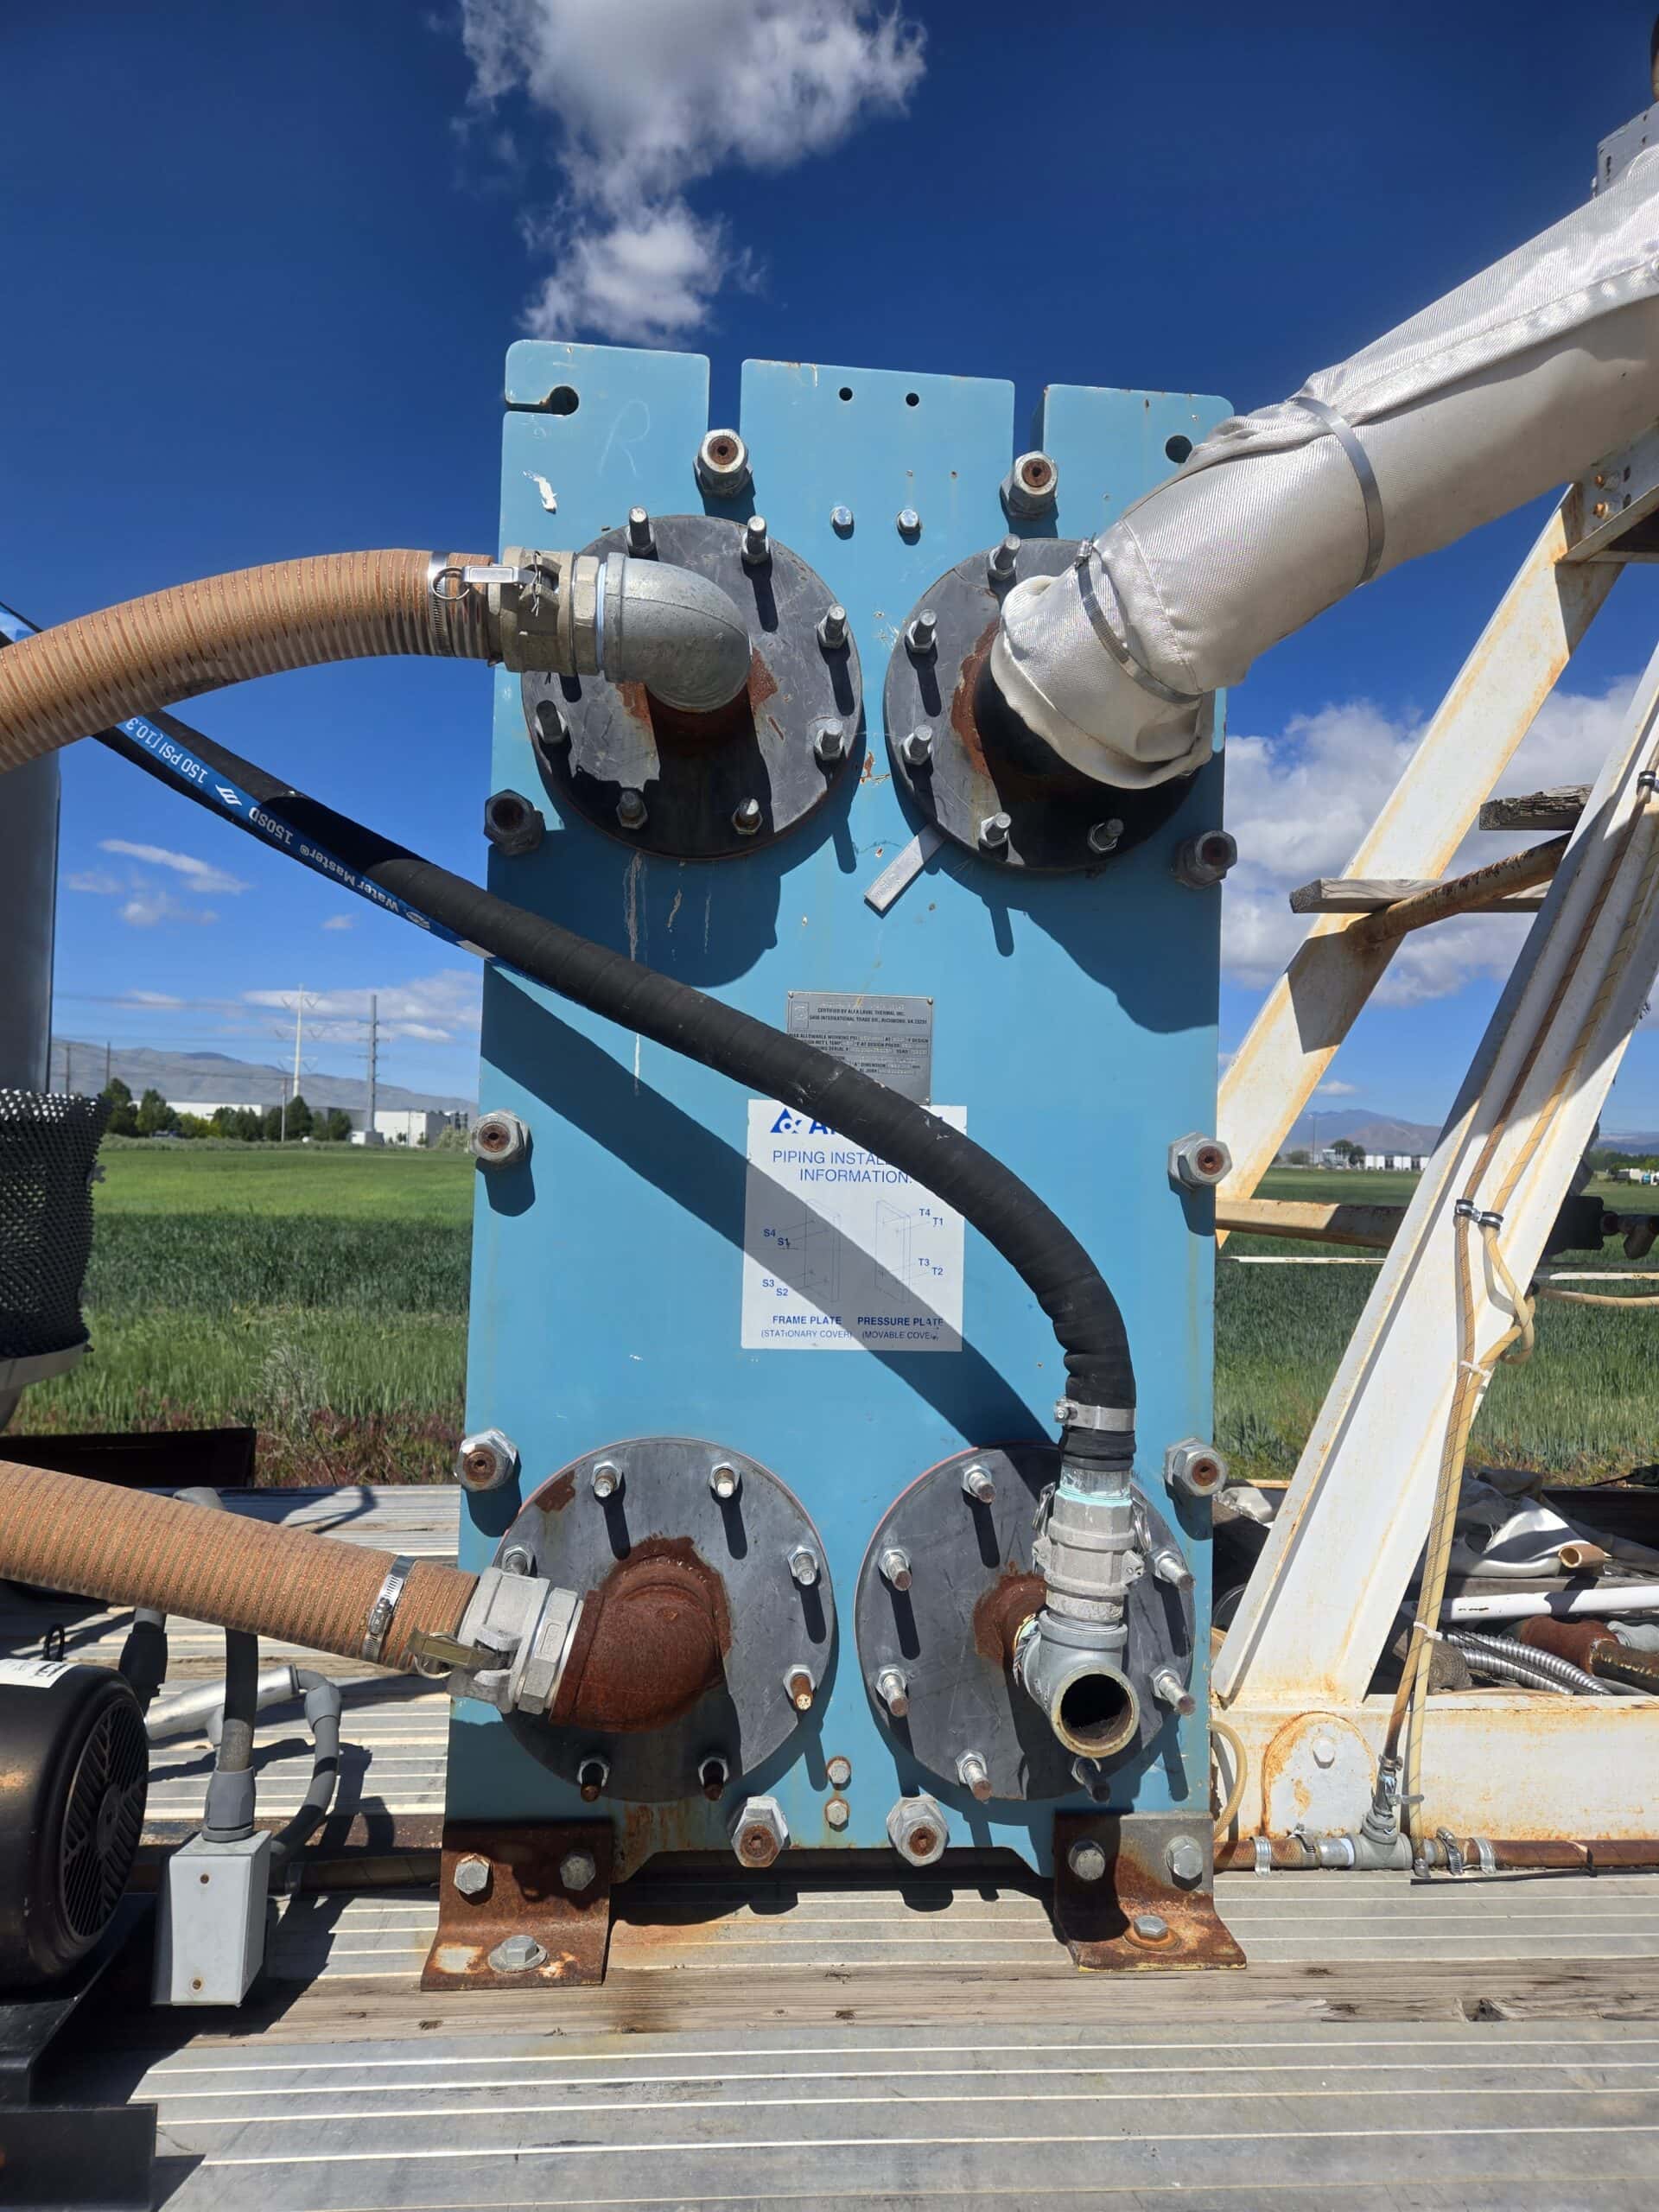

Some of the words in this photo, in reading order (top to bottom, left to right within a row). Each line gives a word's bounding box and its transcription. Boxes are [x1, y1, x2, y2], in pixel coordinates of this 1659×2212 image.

[158, 741, 183, 766] PSI
[180, 759, 207, 784] 150
[248, 807, 294, 844] 150SD
[358, 880, 399, 913] Water
[773, 1150, 825, 1164] PIPING
[919, 1208, 931, 1217] T4
[933, 1217, 944, 1226] T1
[763, 1229, 776, 1237] S4
[777, 1237, 790, 1247] S1
[918, 1258, 930, 1267] T3
[932, 1267, 944, 1276] T2
[776, 1288, 789, 1297] S2
[772, 1315, 807, 1325] FRAME
[810, 1316, 842, 1325] PLATE
[857, 1317, 910, 1326] PRESSURE
[861, 1331, 905, 1340] (MOVABLE
